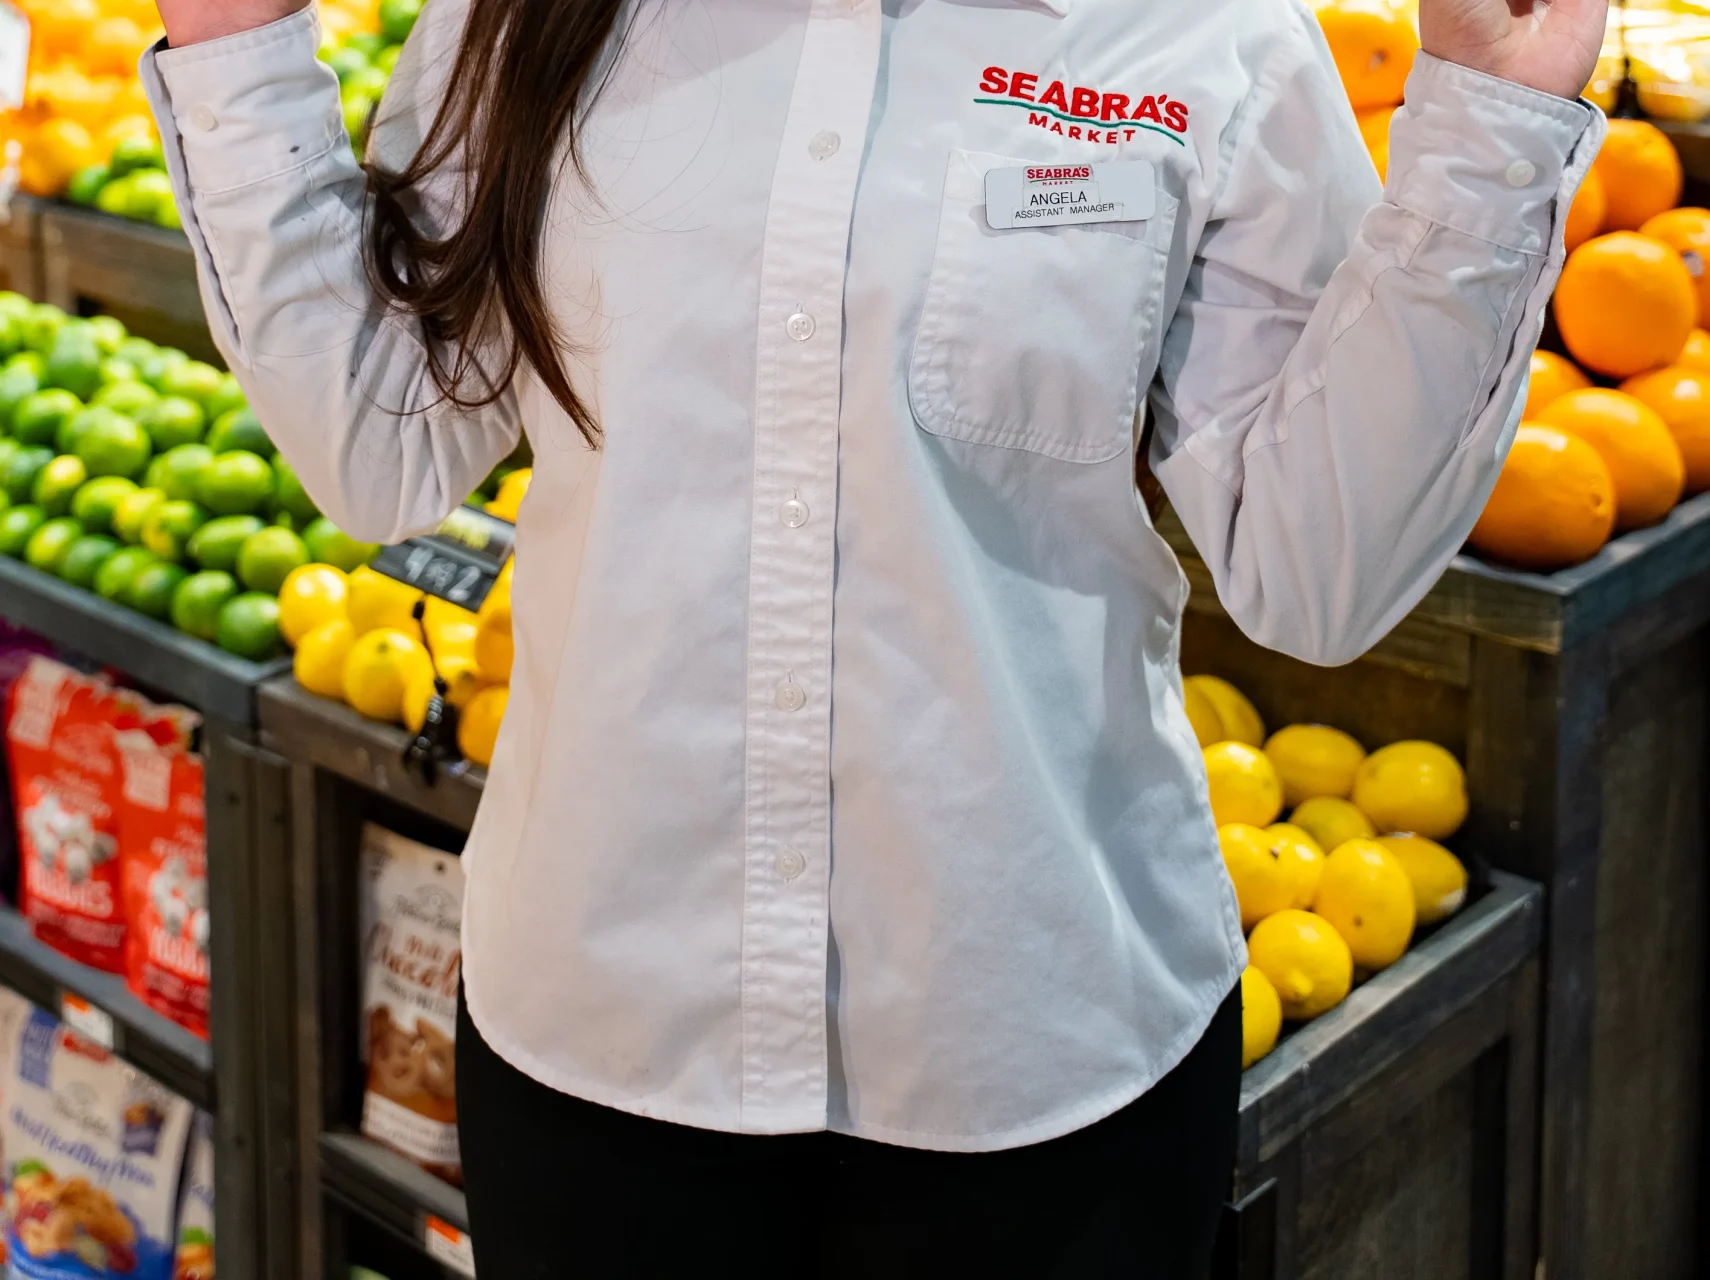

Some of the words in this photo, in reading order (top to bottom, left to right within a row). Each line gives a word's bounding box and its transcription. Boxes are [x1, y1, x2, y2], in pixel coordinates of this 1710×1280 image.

[979, 66, 1189, 133] SEABRA'S
[1028, 112, 1136, 144] MARKET
[1027, 166, 1090, 179] SEABRA'S
[1030, 191, 1087, 206] ANGELA
[1014, 207, 1065, 219] ASSISTANT
[1069, 203, 1115, 215] MANAGER
